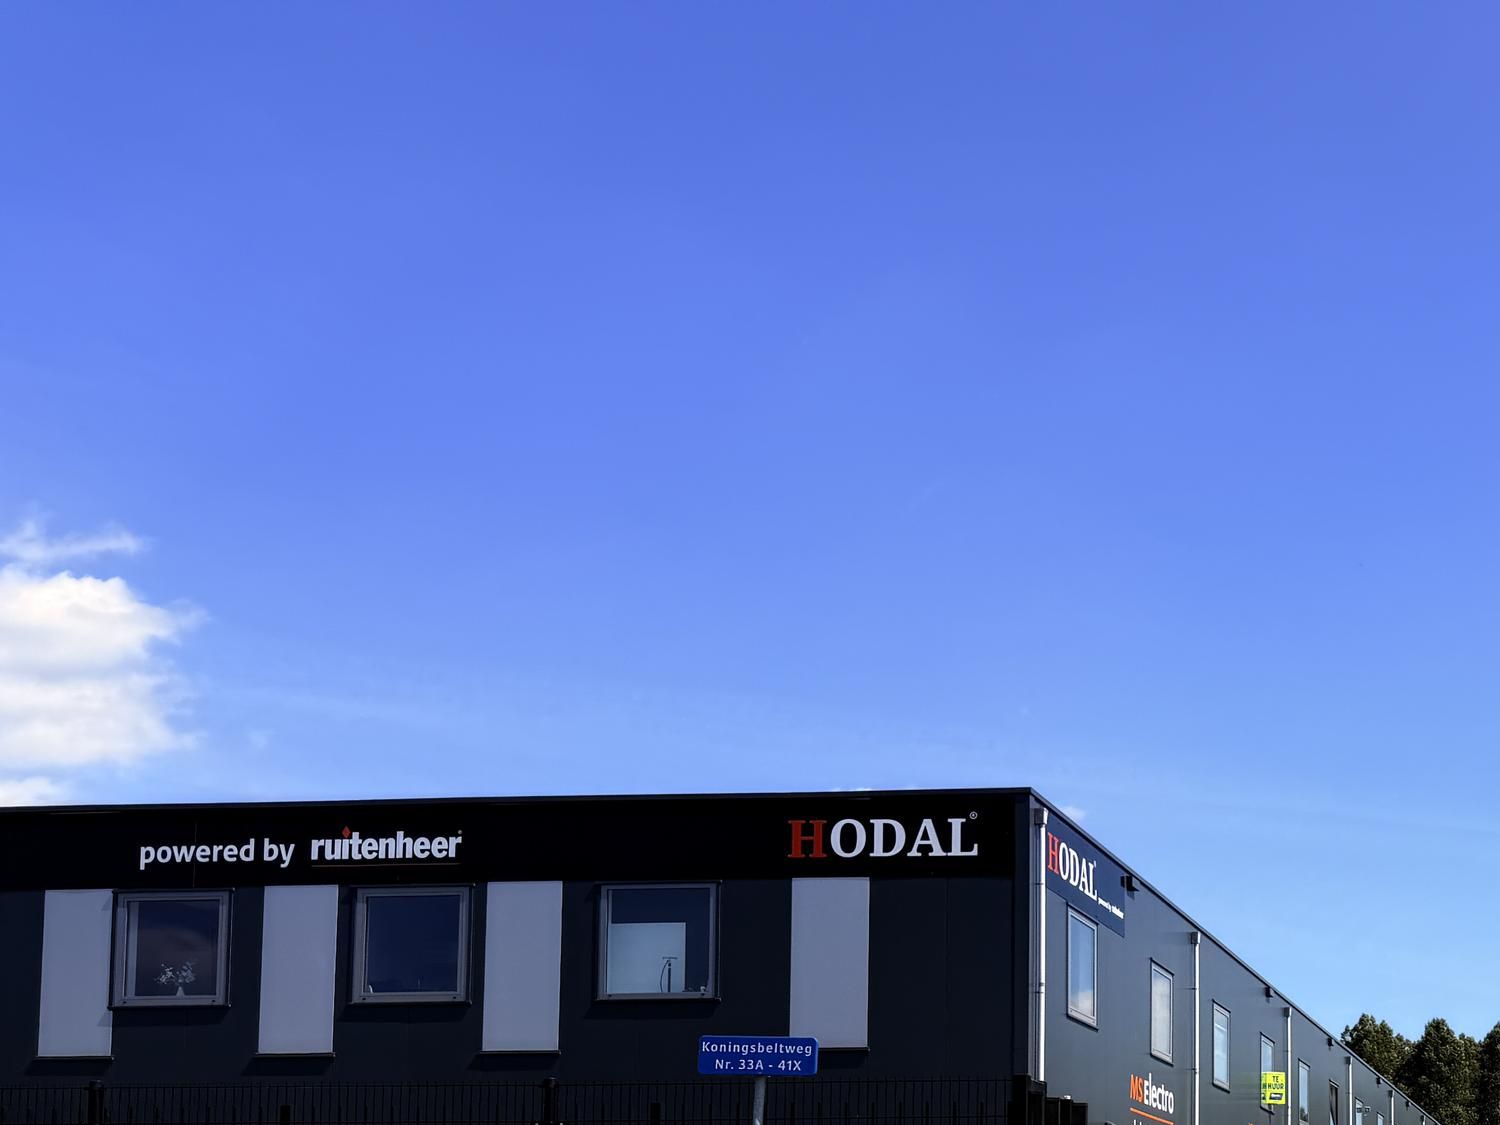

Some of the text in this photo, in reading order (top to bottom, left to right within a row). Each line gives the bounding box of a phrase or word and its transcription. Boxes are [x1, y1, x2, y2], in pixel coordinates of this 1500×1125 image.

[139, 829, 462, 870] powered by ruitenheer
[702, 1041, 812, 1057] Koningsbeltweg
[715, 1059, 734, 1070] Nr.
[738, 1059, 764, 1071] 33A
[778, 1060, 802, 1071] 41X
[1272, 1075, 1280, 1083] TE
